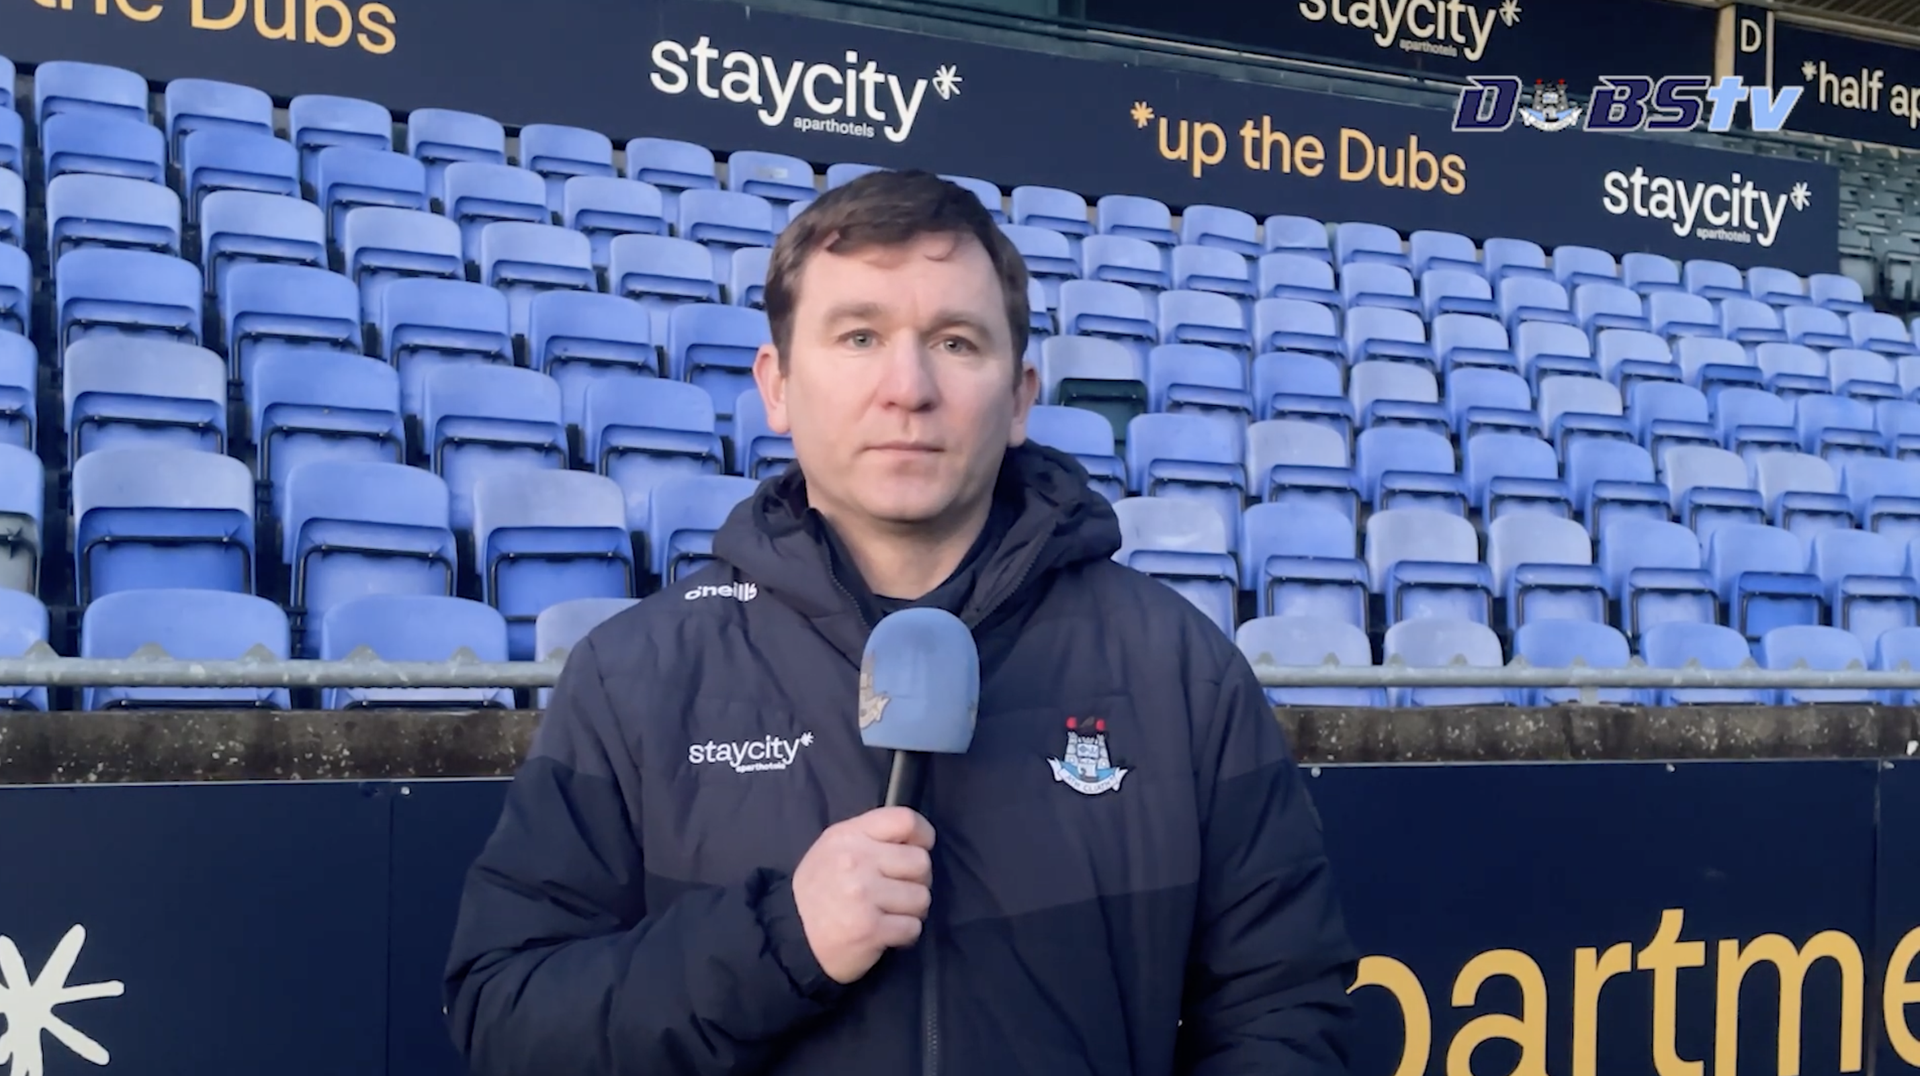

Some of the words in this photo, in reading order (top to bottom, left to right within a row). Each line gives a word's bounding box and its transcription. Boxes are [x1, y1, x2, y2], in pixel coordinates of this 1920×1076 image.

[1740, 18, 1763, 53] D
[1399, 38, 1458, 57] aparthotels
[793, 116, 875, 138] aparthotels
[1239, 115, 1325, 177] the
[1338, 127, 1466, 195] Dubs
[1695, 227, 1751, 244] aparthotels
